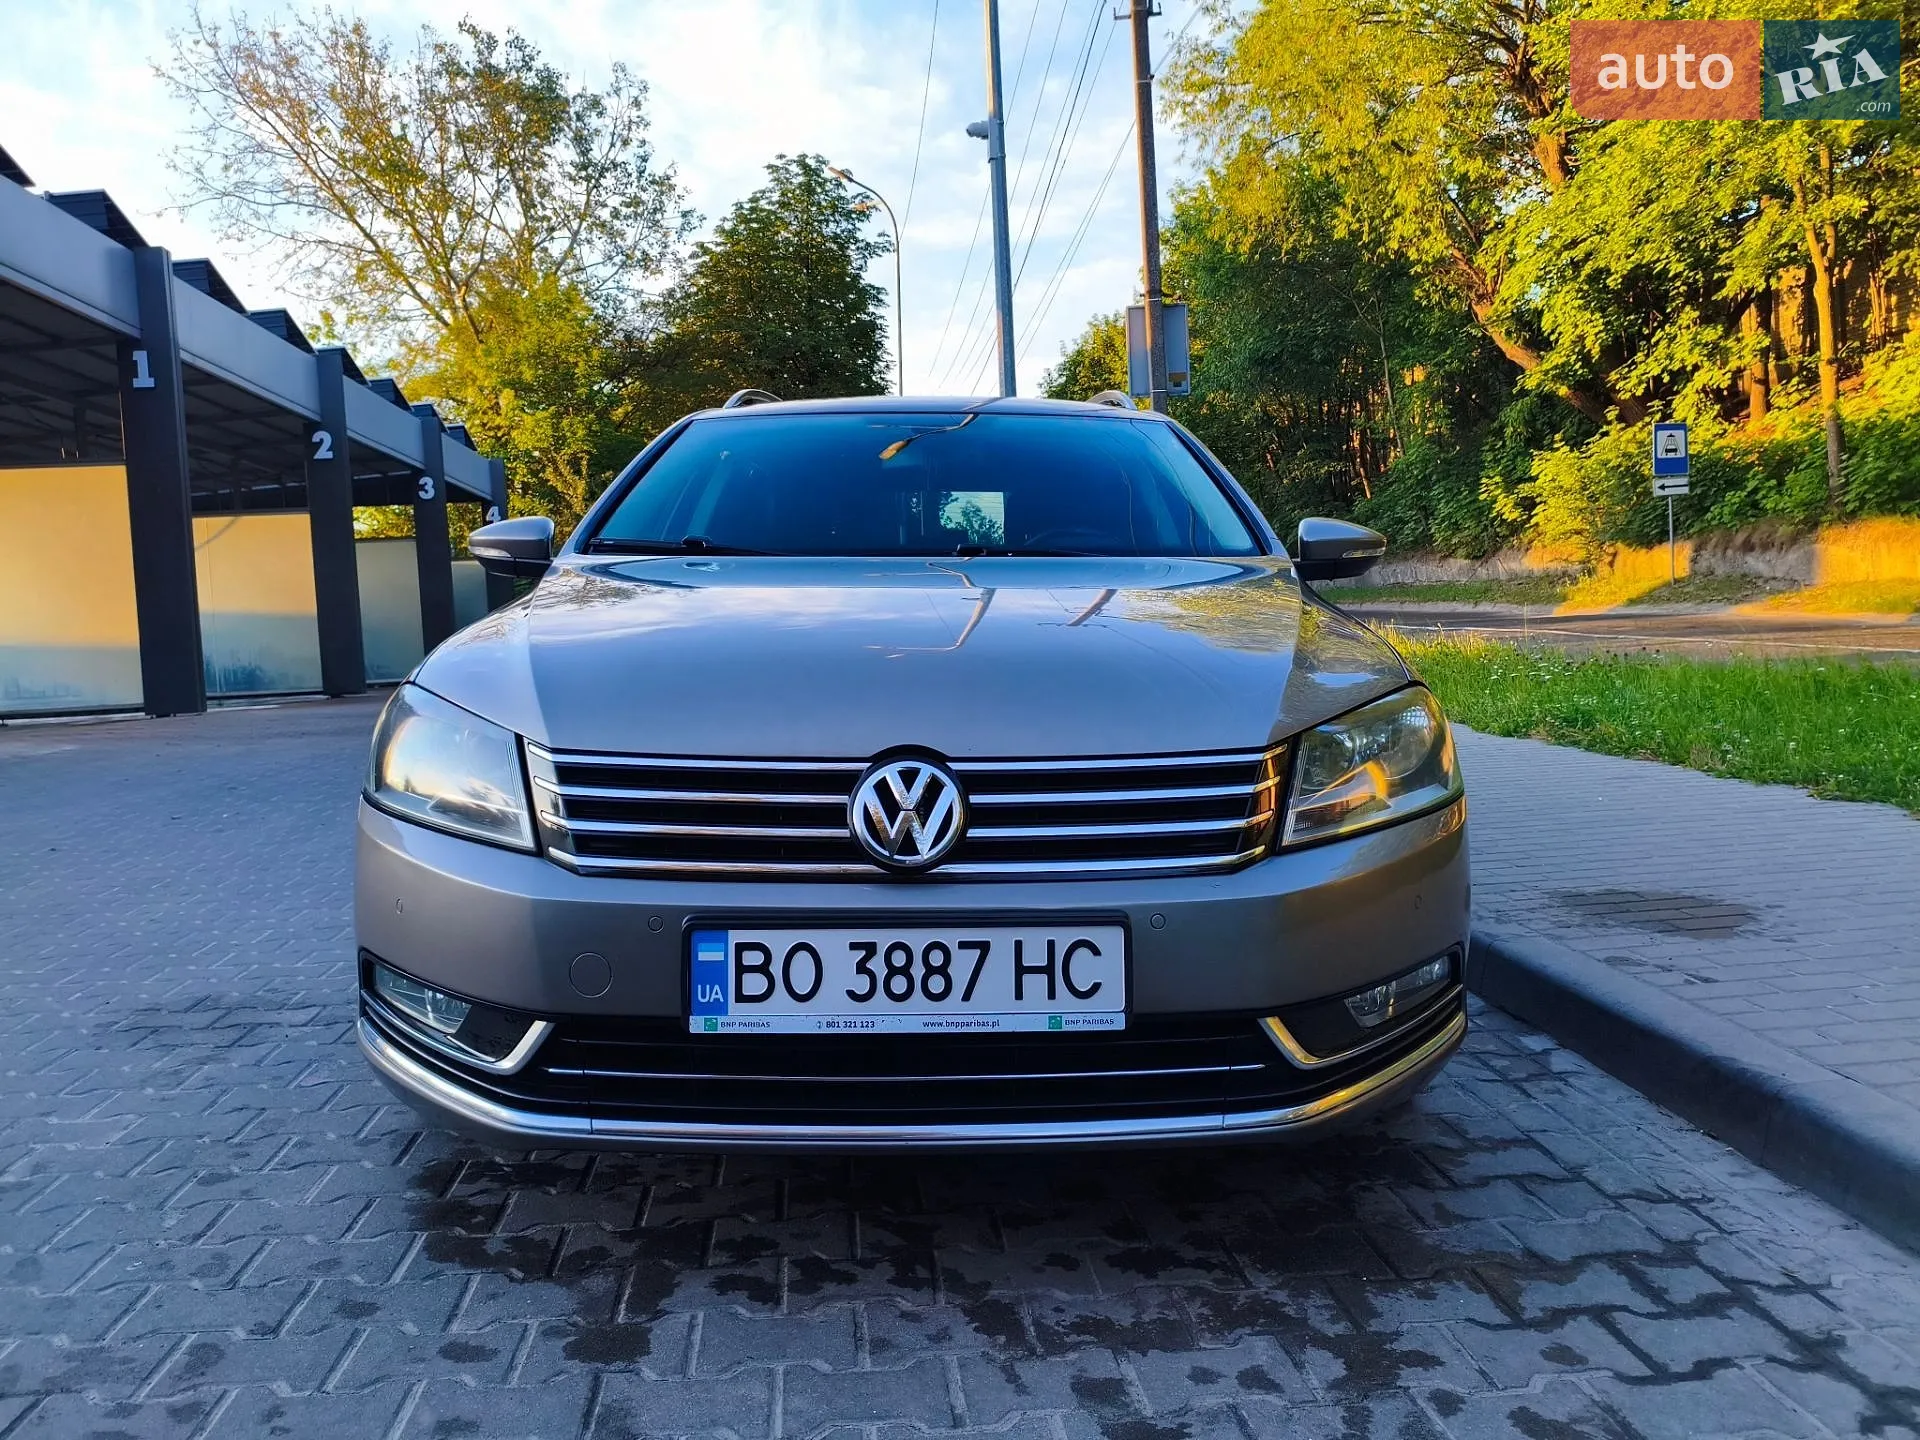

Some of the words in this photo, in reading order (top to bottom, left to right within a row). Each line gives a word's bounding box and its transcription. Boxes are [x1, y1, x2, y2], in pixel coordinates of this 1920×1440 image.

[132, 350, 155, 389] 1
[311, 430, 334, 460] 2
[418, 477, 435, 500] 3
[486, 506, 501, 523] 4
[733, 941, 824, 1003] BO
[845, 940, 991, 1002] 3887
[1013, 939, 1102, 1001] HC
[697, 984, 724, 1003] UA
[720, 1021, 736, 1029] BNP
[738, 1021, 771, 1029] PARIBAS
[825, 1020, 841, 1029] 801
[842, 1020, 858, 1029] 321
[860, 1020, 875, 1029] 123
[922, 1019, 1000, 1030] www.bnpparibas.pl
[1064, 1019, 1080, 1027] BNP
